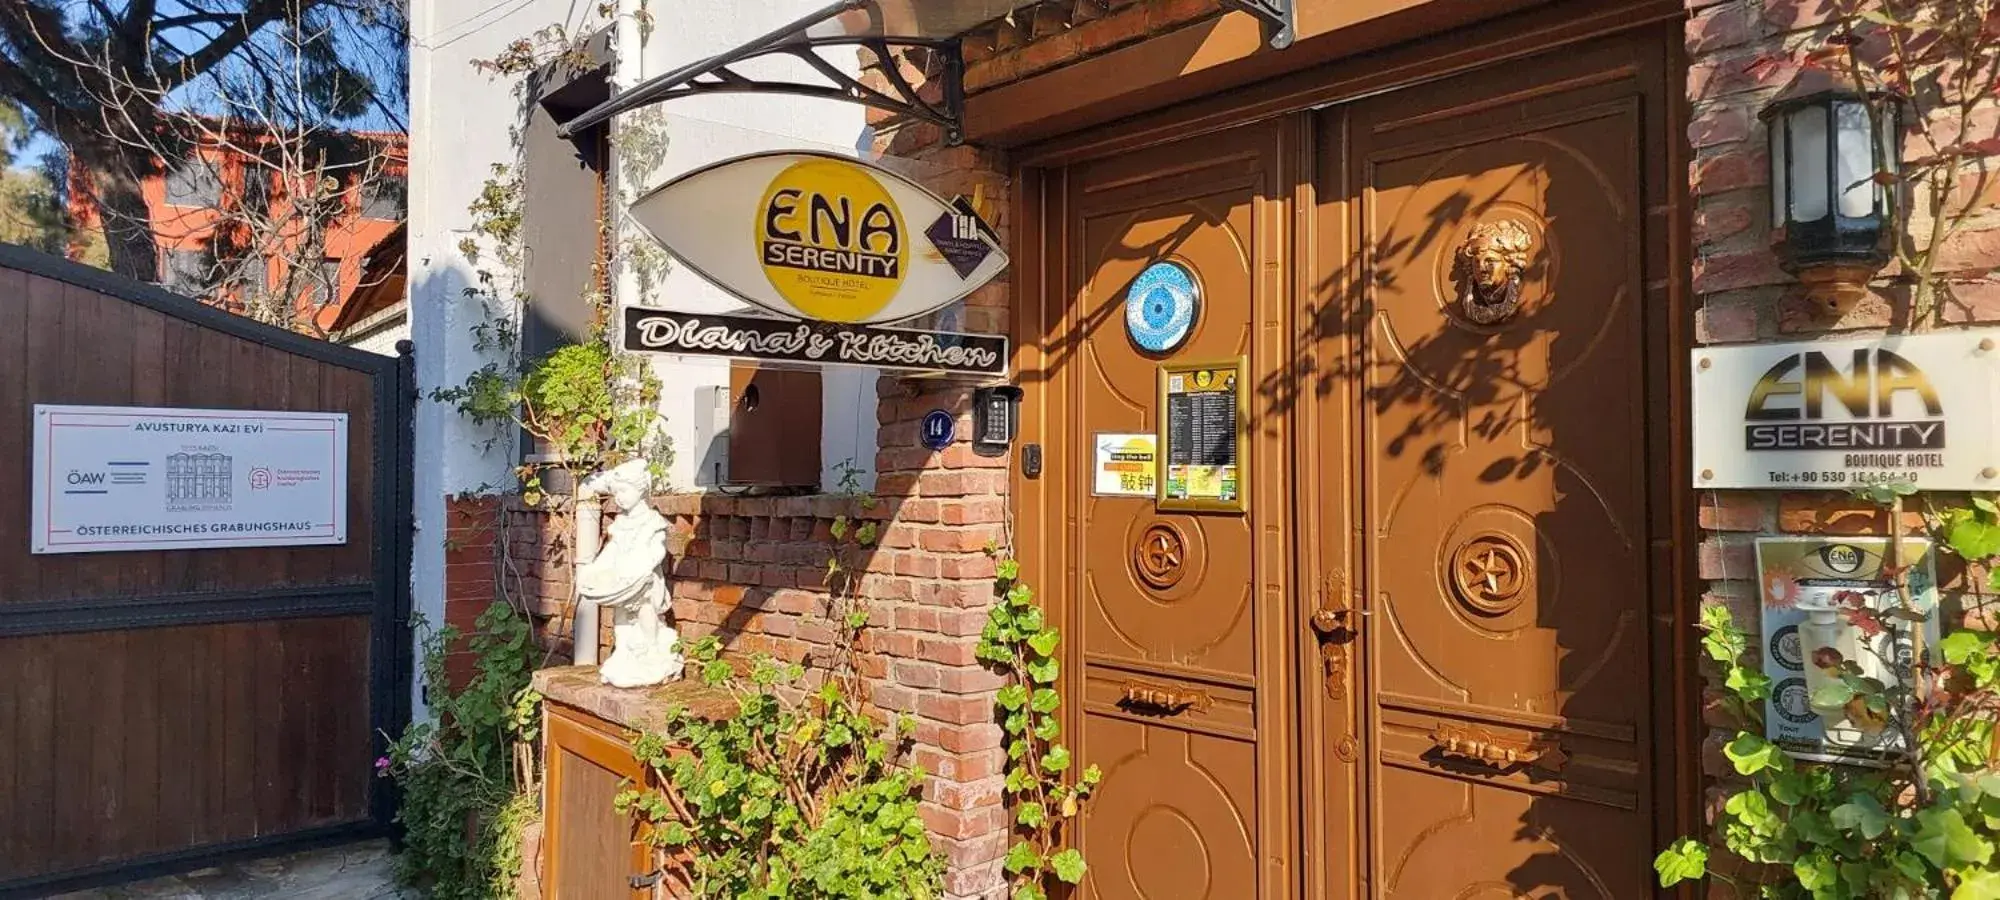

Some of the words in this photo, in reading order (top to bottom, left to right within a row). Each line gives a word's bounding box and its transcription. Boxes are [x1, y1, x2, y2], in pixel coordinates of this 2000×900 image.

[765, 189, 900, 256] ENA
[768, 244, 896, 277] SERENITY
[797, 274, 840, 287] BOUTIQUE
[842, 279, 871, 290] HOTEL
[636, 317, 833, 360] Diana's
[839, 331, 997, 368] Kitchen
[1745, 348, 1943, 420] ENA
[135, 422, 210, 433] AVUSTURYA
[213, 423, 240, 434] KAZI
[930, 418, 942, 436] 14
[1752, 423, 1938, 447] SERENITY
[1845, 454, 1903, 468] BOUTIQUE
[1907, 454, 1944, 468] HOTEL
[67, 469, 105, 485] ÖAW
[1120, 472, 1153, 491] 敲钟
[1822, 471, 1846, 482] 530
[77, 523, 208, 537] ÖSTERREICHISCHES
[210, 520, 312, 534] GRABUNGSHAUS
[1831, 550, 1855, 561] ENA
